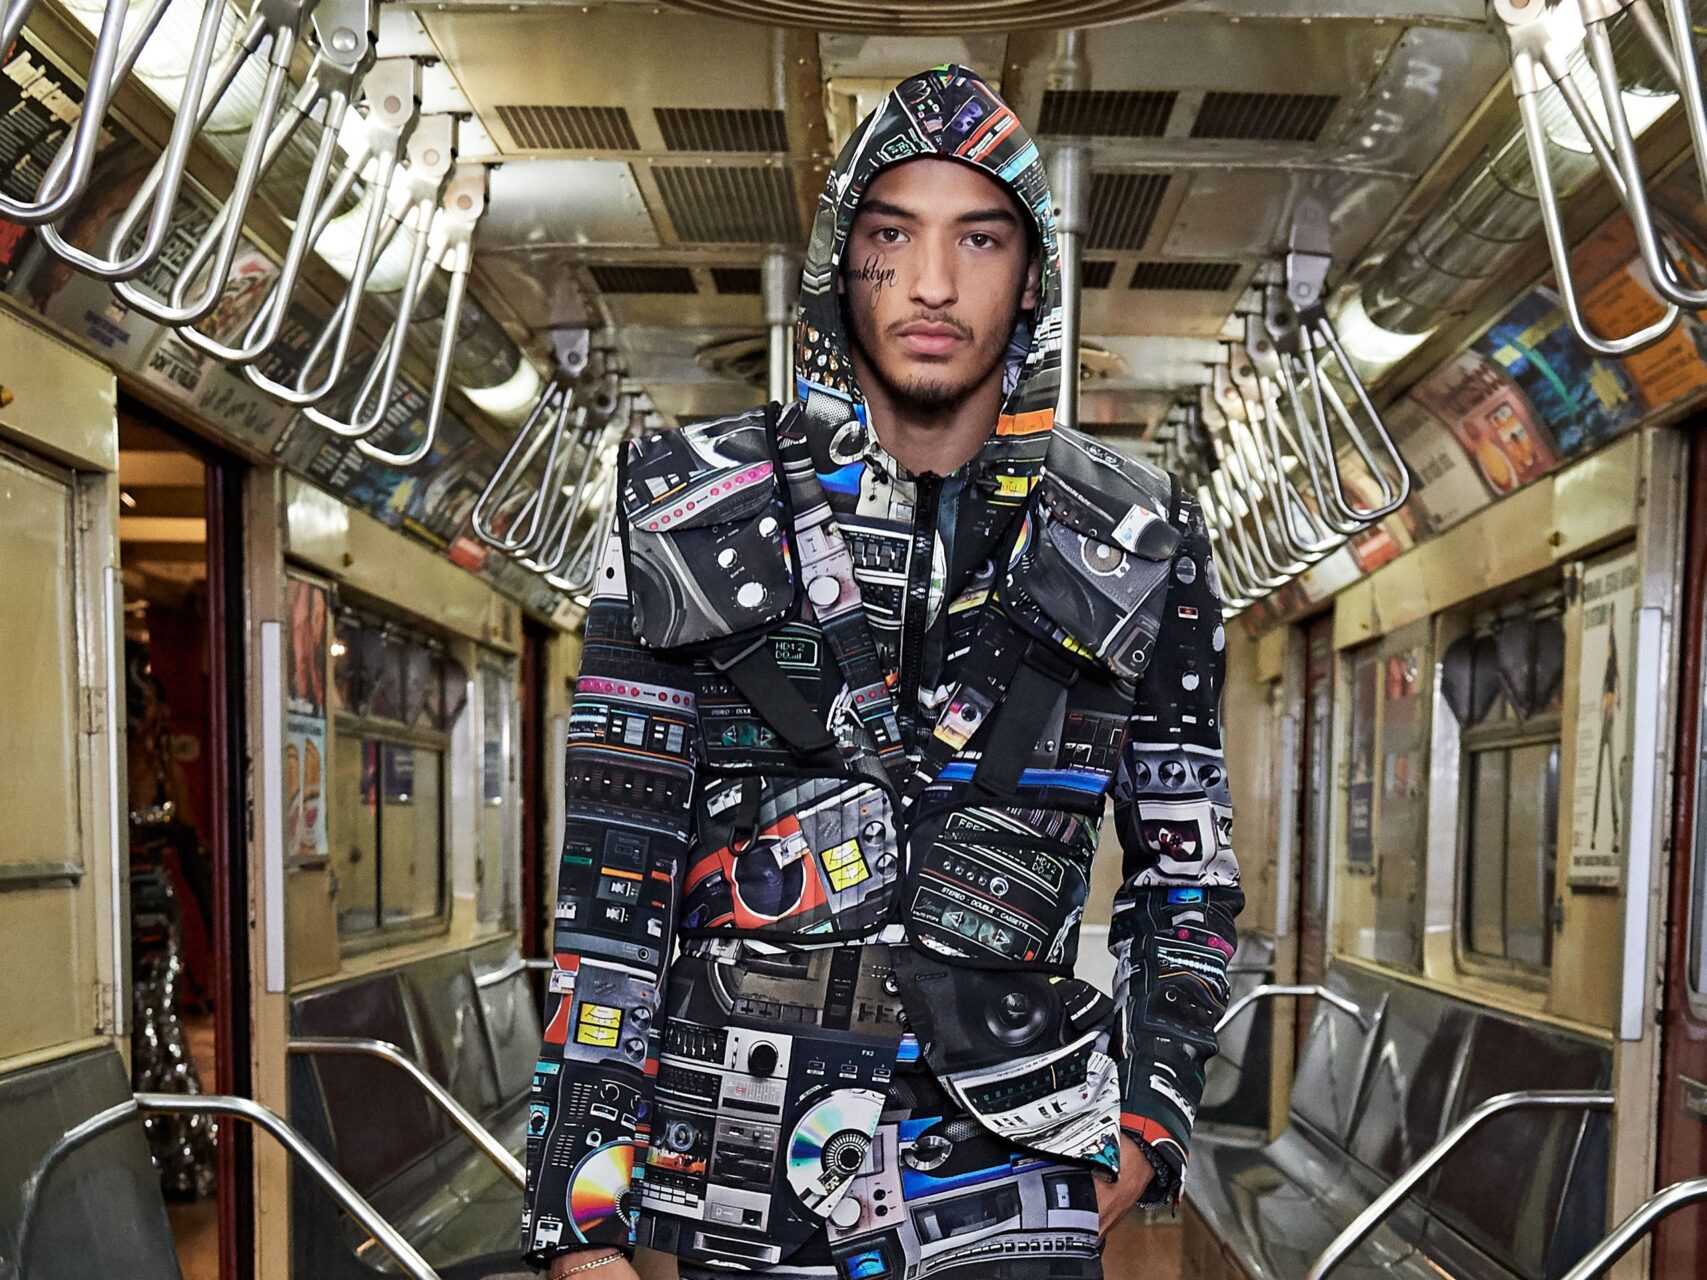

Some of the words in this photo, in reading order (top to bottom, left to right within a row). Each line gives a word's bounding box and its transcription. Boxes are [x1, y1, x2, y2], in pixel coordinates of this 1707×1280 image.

[941, 887, 966, 902] STEREO
[970, 899, 995, 914] DOUBLE
[1000, 912, 1029, 930] CASSETTE
